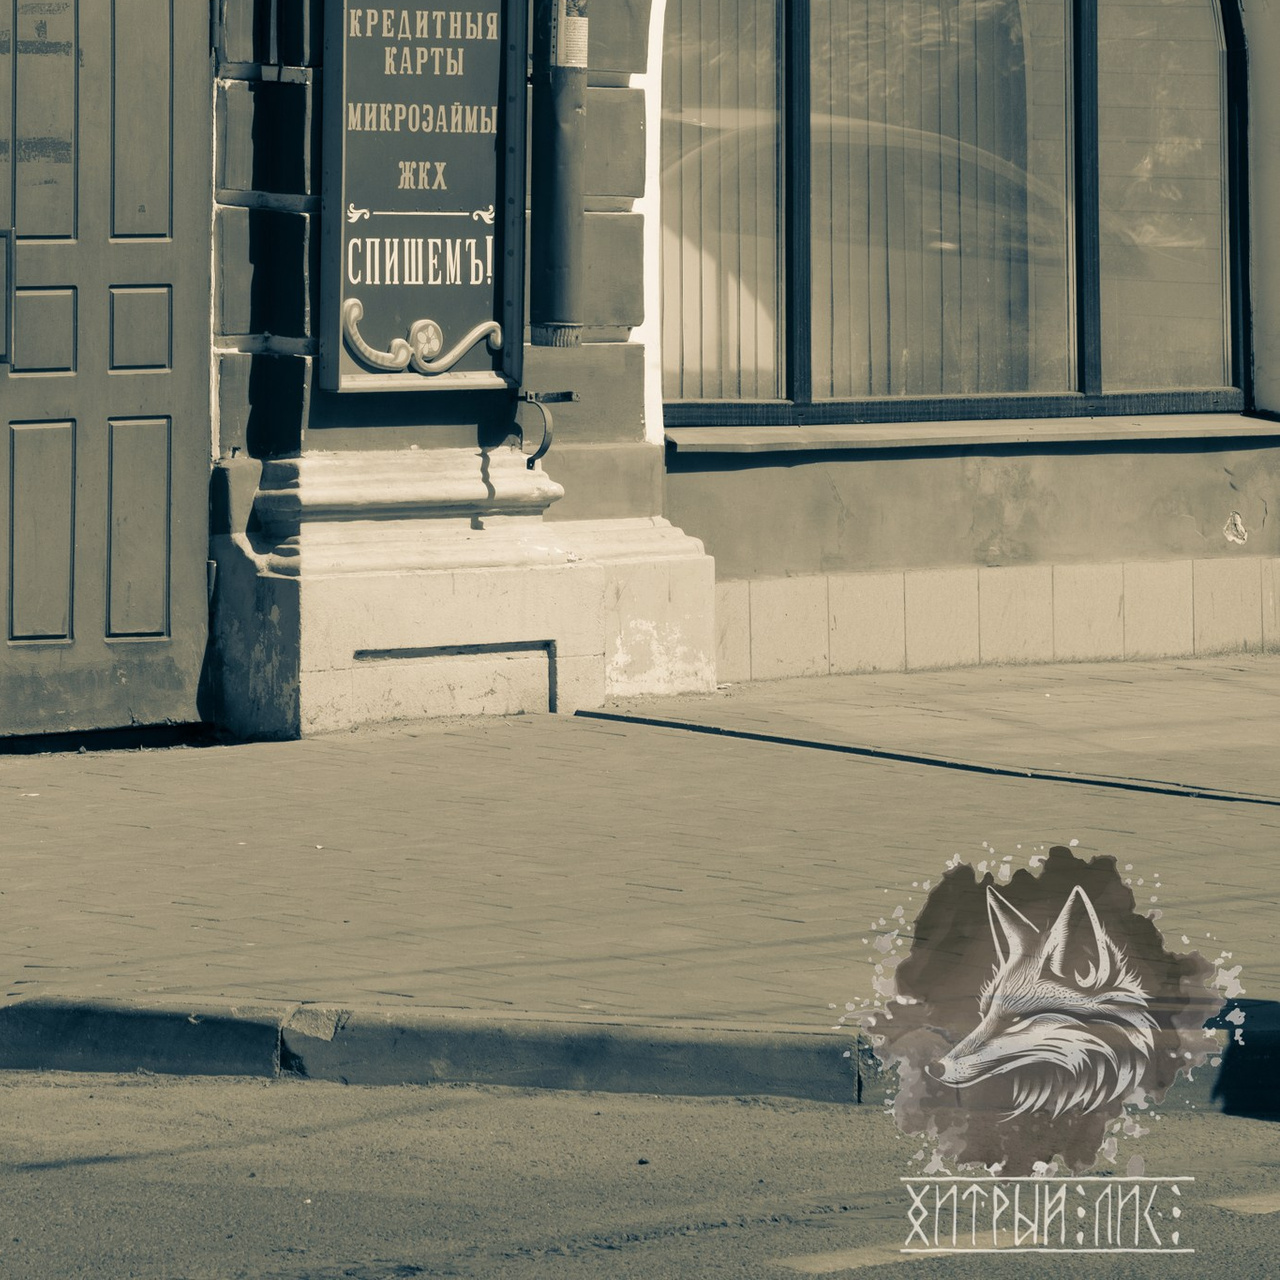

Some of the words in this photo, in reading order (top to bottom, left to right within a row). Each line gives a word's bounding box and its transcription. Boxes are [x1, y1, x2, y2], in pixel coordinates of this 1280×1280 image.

[349, 9, 498, 41] КРЕДИТНЫЯ
[384, 46, 464, 76] КАРТЫ
[347, 102, 498, 134] МИКРОЗАЙМЫ
[398, 160, 448, 190] ЖКХ
[347, 235, 494, 285] СПИШЕМЪ!
